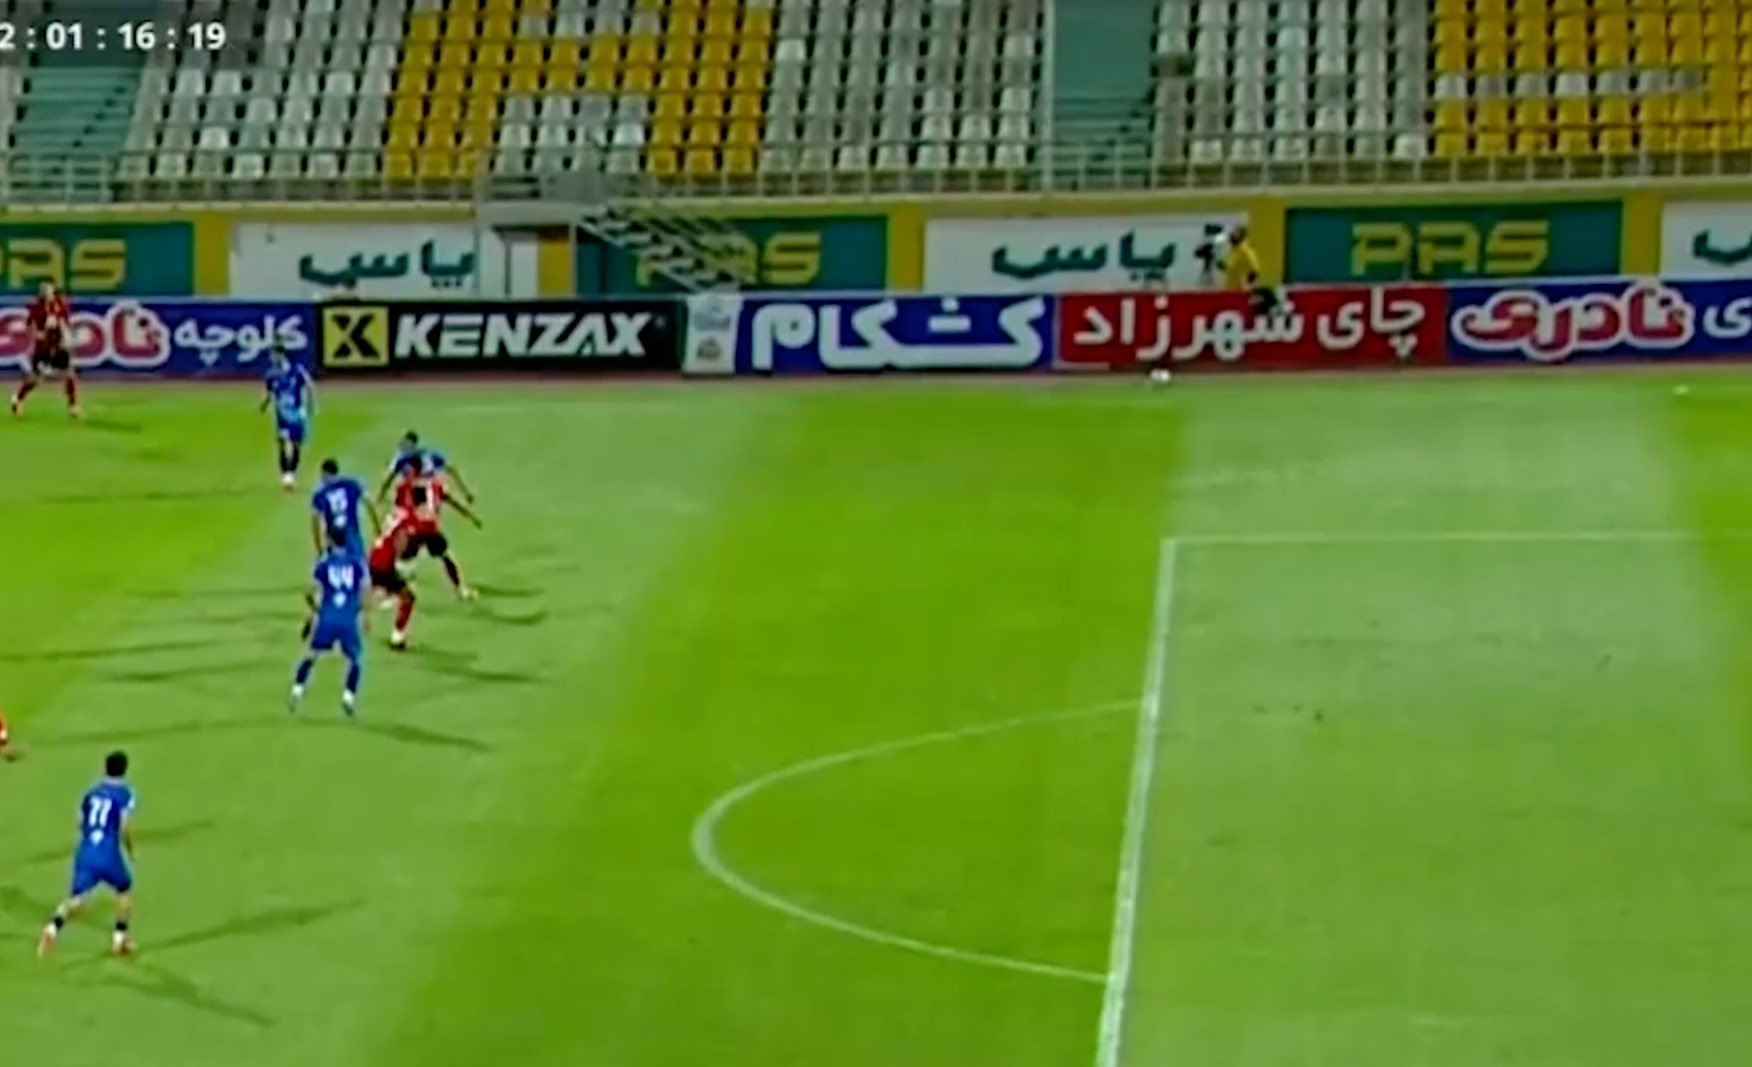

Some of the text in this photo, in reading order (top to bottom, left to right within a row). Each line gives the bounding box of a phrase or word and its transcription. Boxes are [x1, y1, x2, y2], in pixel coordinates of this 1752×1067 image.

[1351, 220, 1549, 275] PAS
[174, 314, 308, 362] کلوچه
[394, 312, 650, 358] KENZAX
[750, 298, 1046, 371] کشکام
[1073, 286, 1426, 360] چای شهرزاد
[1452, 279, 1695, 361] نادری
